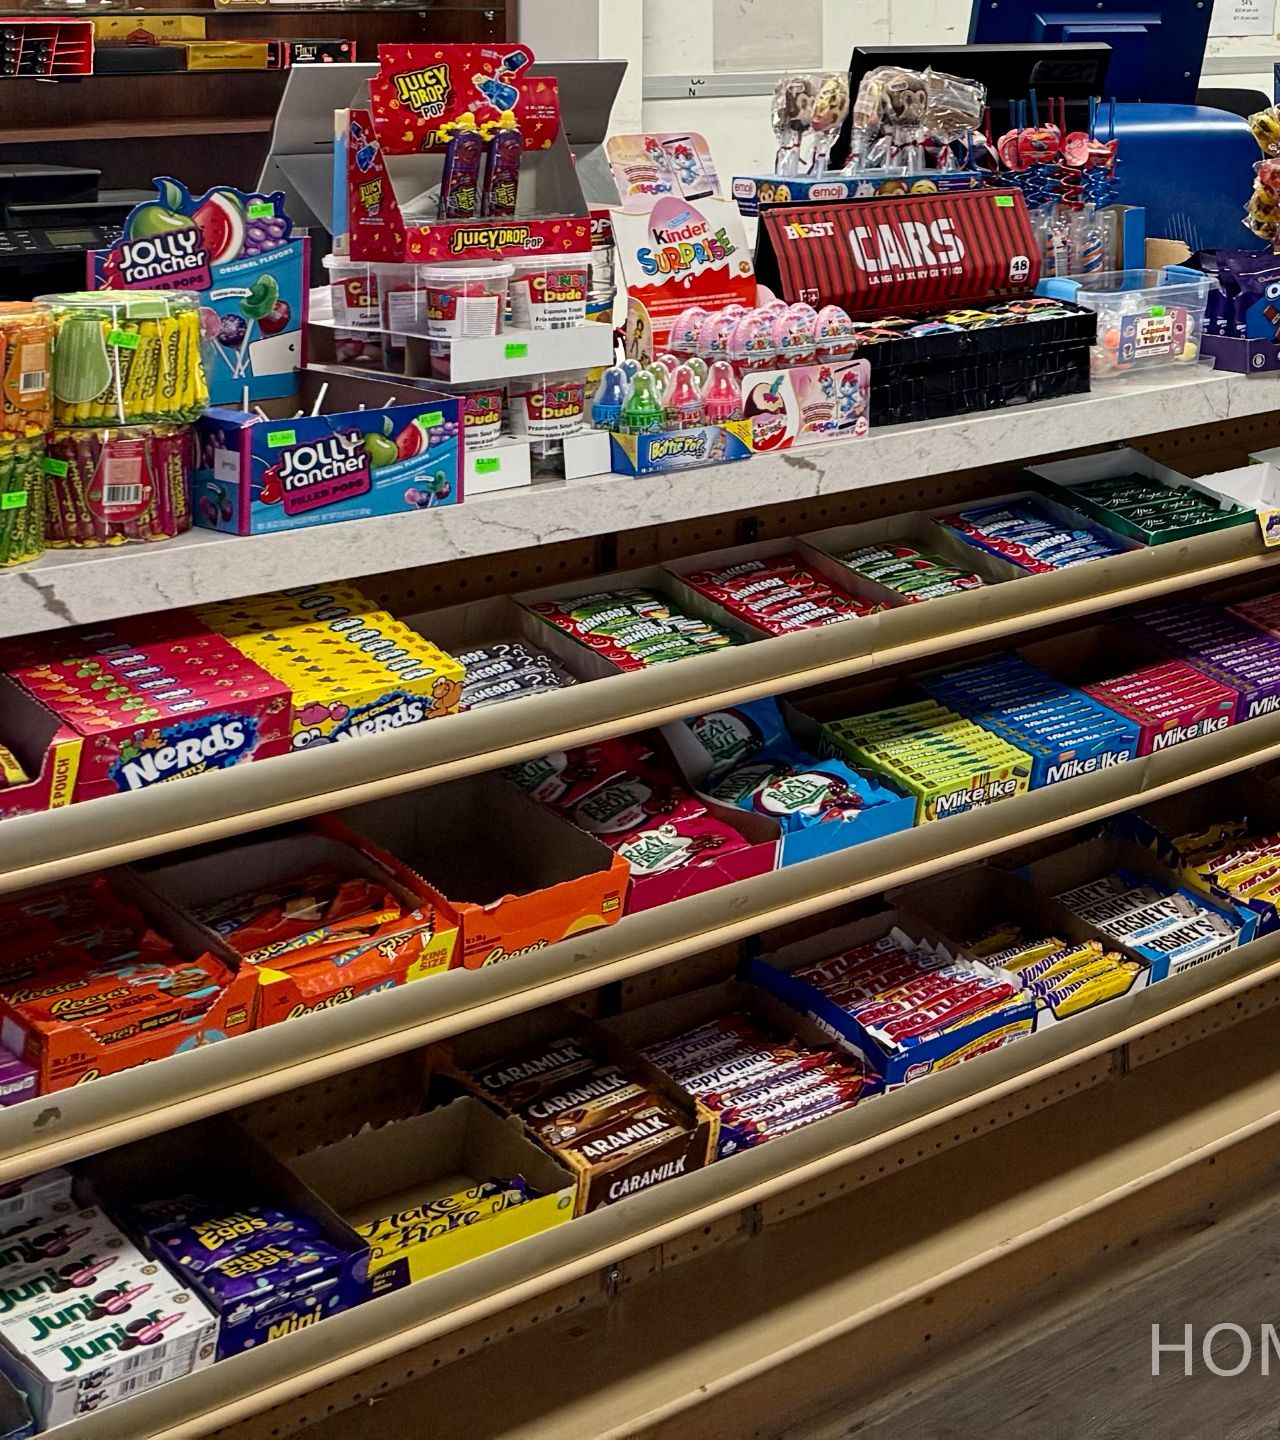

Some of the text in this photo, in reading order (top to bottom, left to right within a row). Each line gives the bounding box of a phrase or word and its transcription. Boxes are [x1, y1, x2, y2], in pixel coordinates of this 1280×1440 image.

[395, 66, 450, 98] JUICY
[410, 85, 445, 108] DROP
[421, 102, 445, 120] POP
[812, 186, 845, 198] emoji
[454, 227, 543, 252] JUICY DROP POP
[652, 221, 707, 245] Kinder
[849, 218, 965, 273] CARS
[119, 230, 197, 269] JOLLY
[636, 228, 736, 276] SURPRISE
[125, 252, 205, 282] rancher
[1012, 259, 1027, 272] 48
[173, 274, 204, 289] POPS
[543, 290, 582, 302] Dude
[1140, 325, 1171, 337] Capsule
[464, 412, 500, 427] Dude
[541, 404, 580, 419] Dude
[279, 432, 365, 477] JOLLY
[285, 453, 366, 490] rancher
[331, 478, 364, 497] POPS
[730, 576, 785, 601] AIRHEADS
[576, 605, 632, 634] AIRHEADS
[613, 624, 672, 648] AIRHEADS
[1153, 715, 1229, 752] Mike Ike
[1046, 748, 1130, 785] Mike Ike
[935, 778, 1017, 814] Mike Ike
[623, 837, 670, 860] REAL
[1102, 900, 1177, 939] HERSHEY'S
[419, 958, 447, 972] SIZE
[420, 947, 448, 964] KING
[883, 1012, 932, 1037] BIG
[483, 1045, 583, 1089] CARAMILK
[528, 1073, 628, 1119] CARAMILK
[609, 1154, 687, 1200] CARAMILK
[190, 1211, 251, 1237] Mini
[198, 1216, 269, 1251] Eggs
[220, 1244, 280, 1269] Mini
[224, 1250, 294, 1279] Eggs
[267, 1304, 323, 1342] Mini
